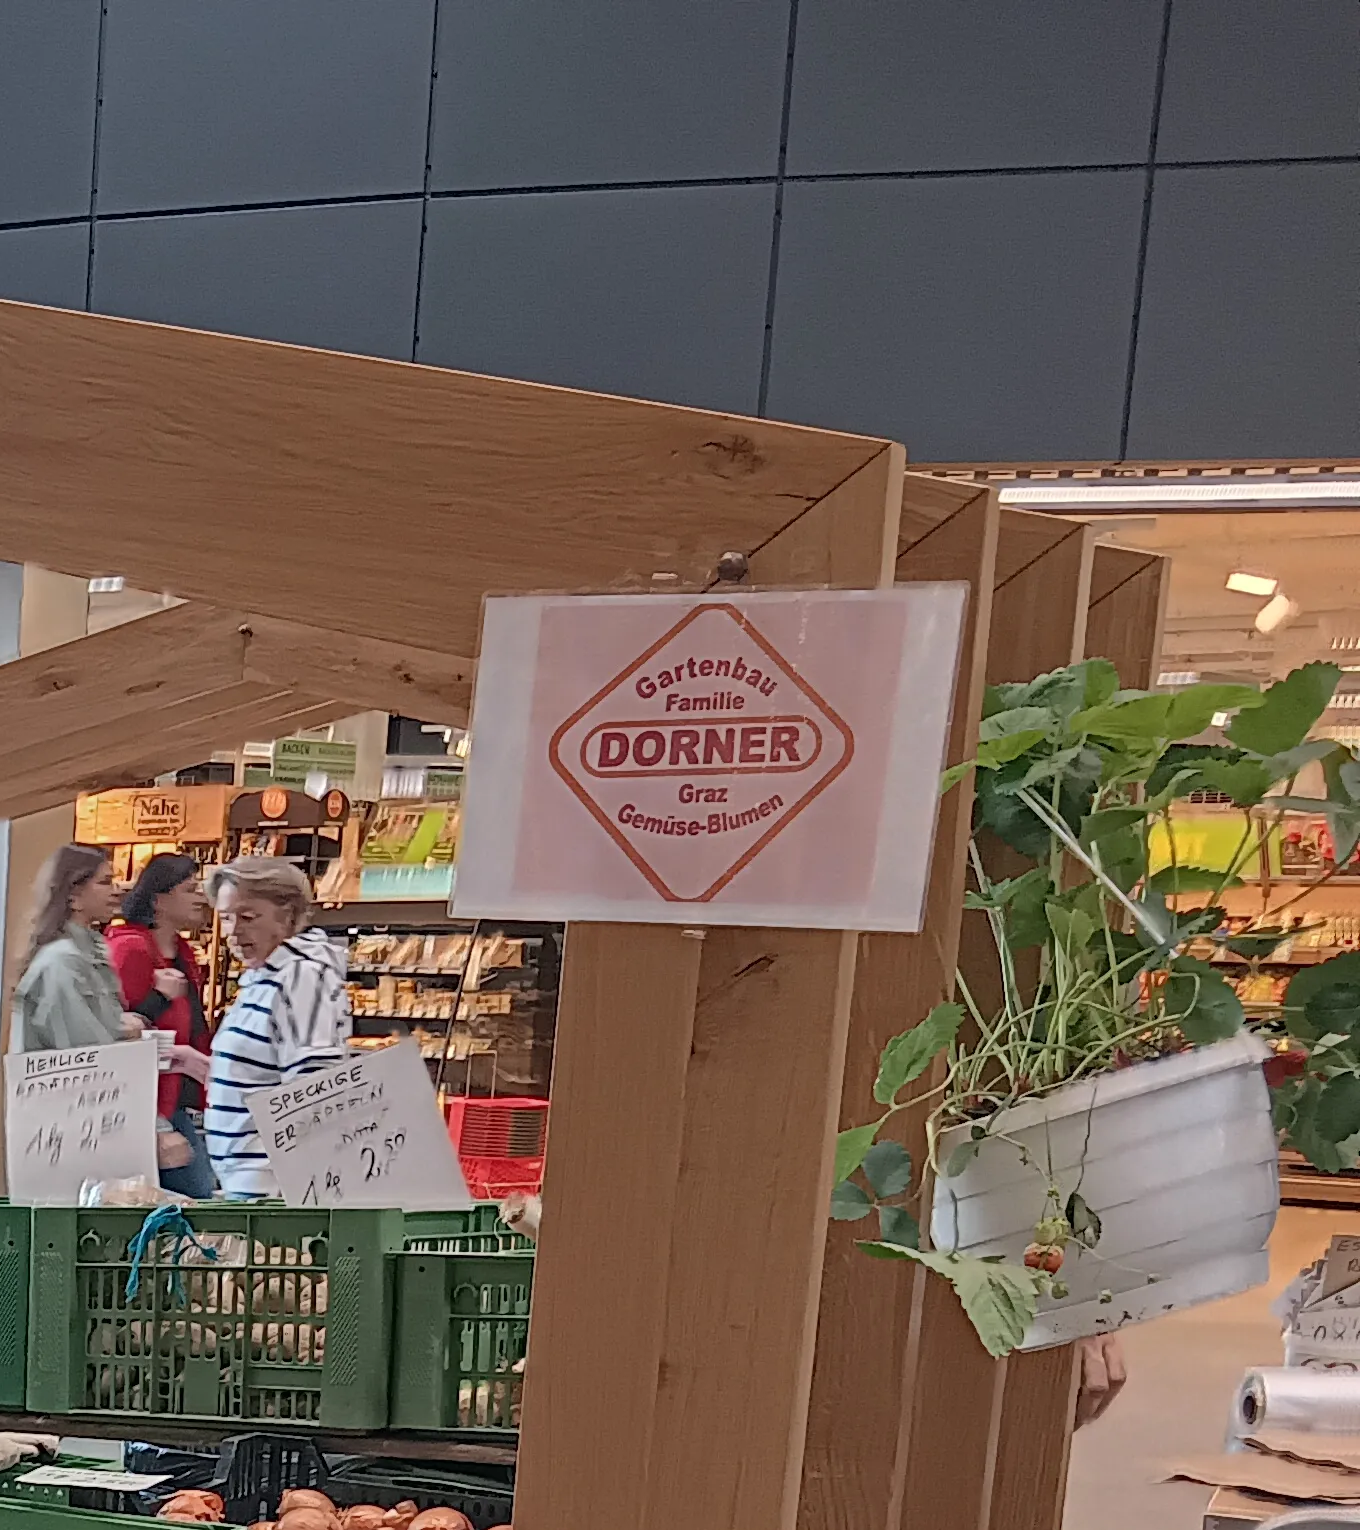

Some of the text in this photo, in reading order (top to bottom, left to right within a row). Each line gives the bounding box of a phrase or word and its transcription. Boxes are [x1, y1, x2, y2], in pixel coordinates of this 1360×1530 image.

[636, 657, 777, 699] Gartenbau
[665, 692, 744, 712] Familie
[596, 725, 801, 768] DORNER
[618, 794, 784, 836] Gemüse-Blumen
[679, 784, 729, 804] Graz
[26, 1051, 99, 1074] MEHLIGE
[270, 1065, 363, 1115] SPECKIGE
